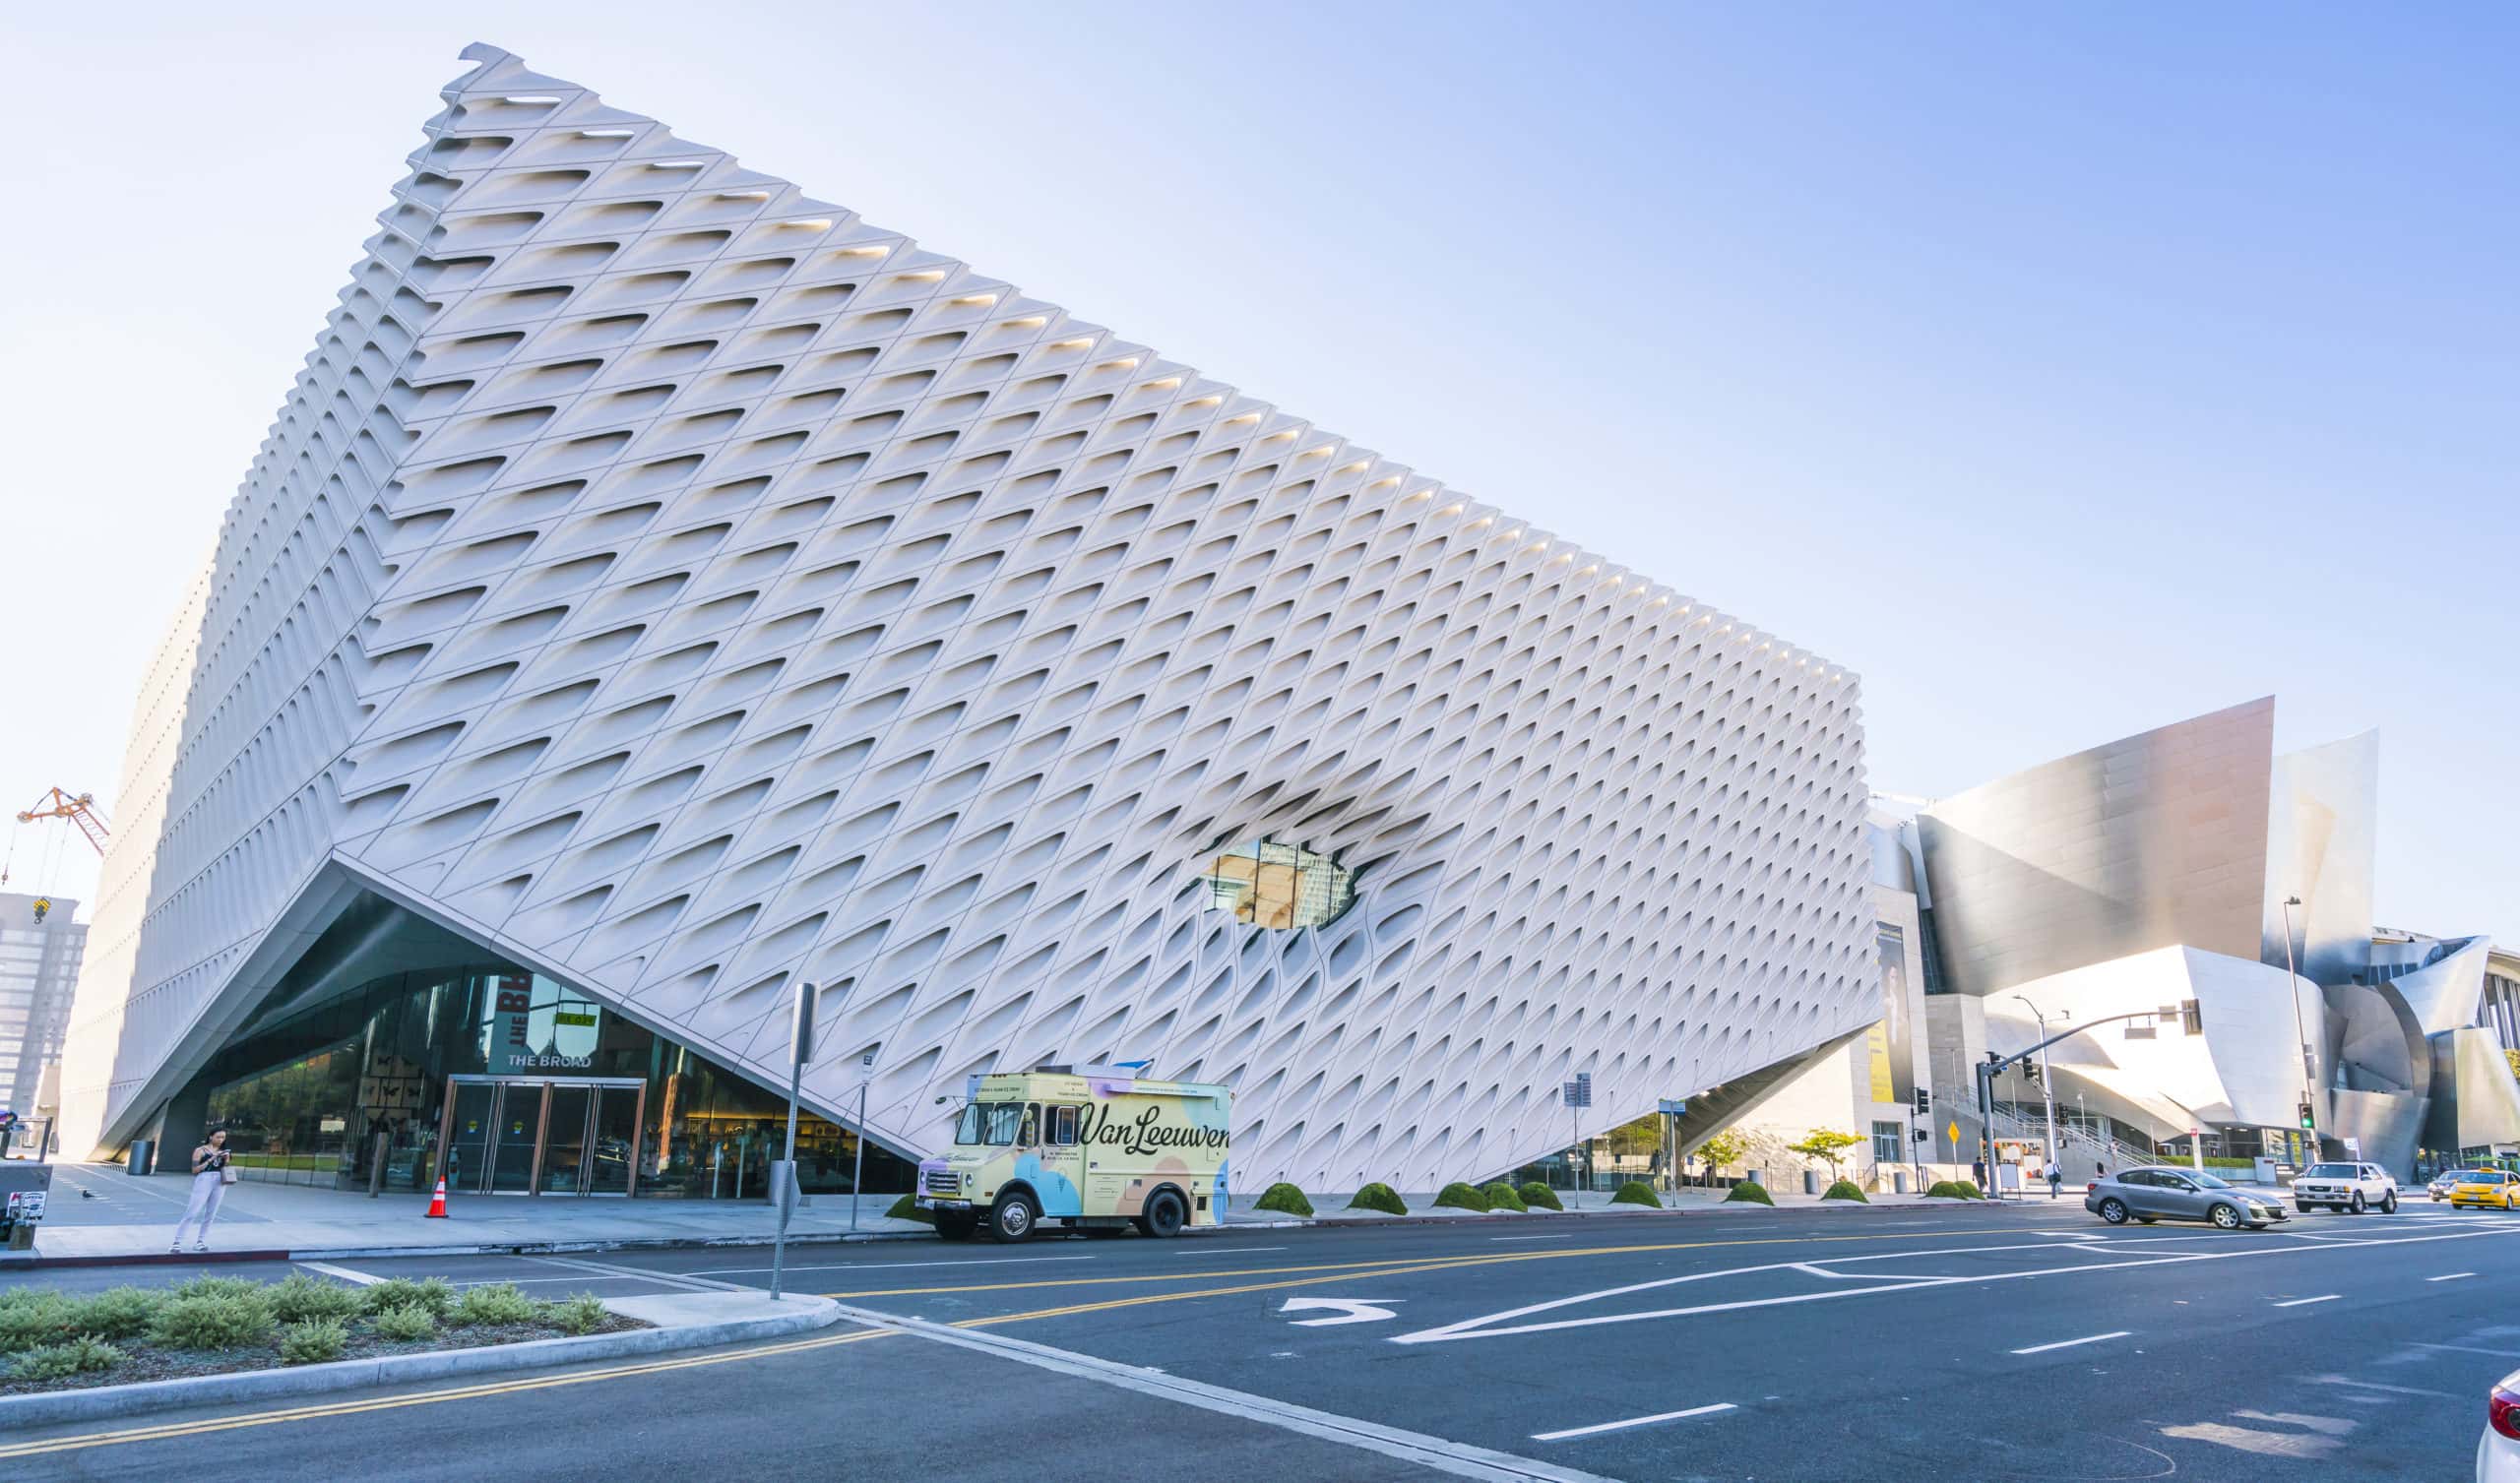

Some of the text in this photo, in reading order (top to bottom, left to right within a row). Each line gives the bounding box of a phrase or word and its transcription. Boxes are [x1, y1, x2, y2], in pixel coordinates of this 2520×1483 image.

[508, 1055, 592, 1068] THE BROAD
[1079, 1101, 1229, 1155] Van Leeuwen
